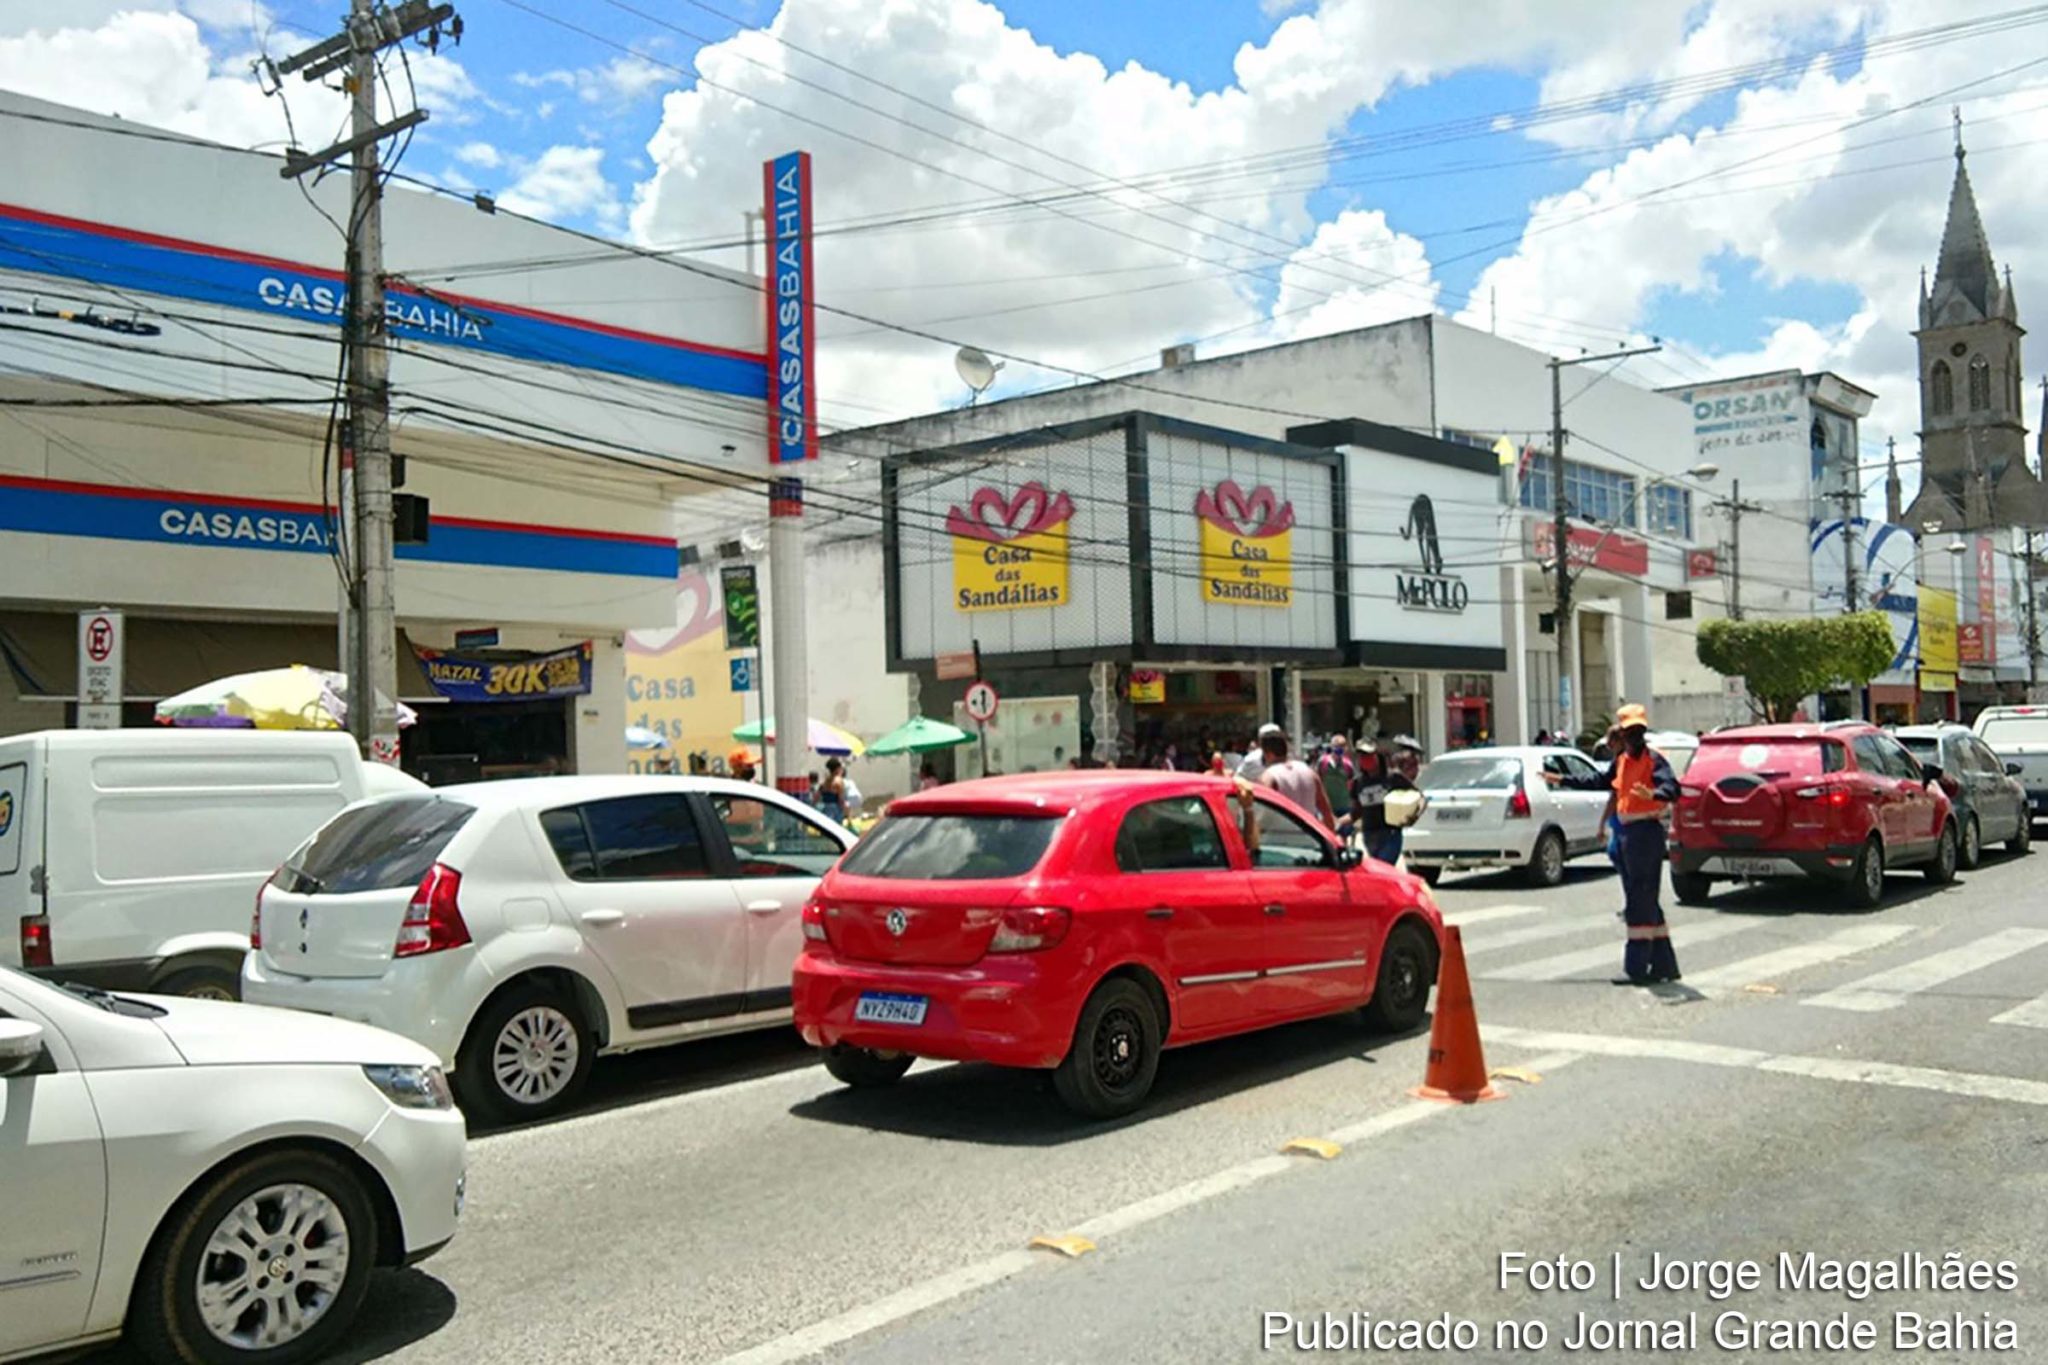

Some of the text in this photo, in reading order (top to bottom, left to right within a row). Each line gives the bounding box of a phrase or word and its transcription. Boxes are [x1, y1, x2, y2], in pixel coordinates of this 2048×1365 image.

[777, 165, 802, 447] CASASBAHIA
[1694, 389, 1794, 421] ORSAN
[159, 509, 333, 547] CASASBA
[983, 546, 1032, 565] Casa
[1231, 539, 1269, 561] Casa
[995, 568, 1021, 583] das
[1241, 564, 1261, 578] das
[959, 583, 1060, 608] Sandálias
[1211, 578, 1289, 603] Sandálias
[484, 661, 548, 695] 30K
[626, 674, 696, 702] Casa
